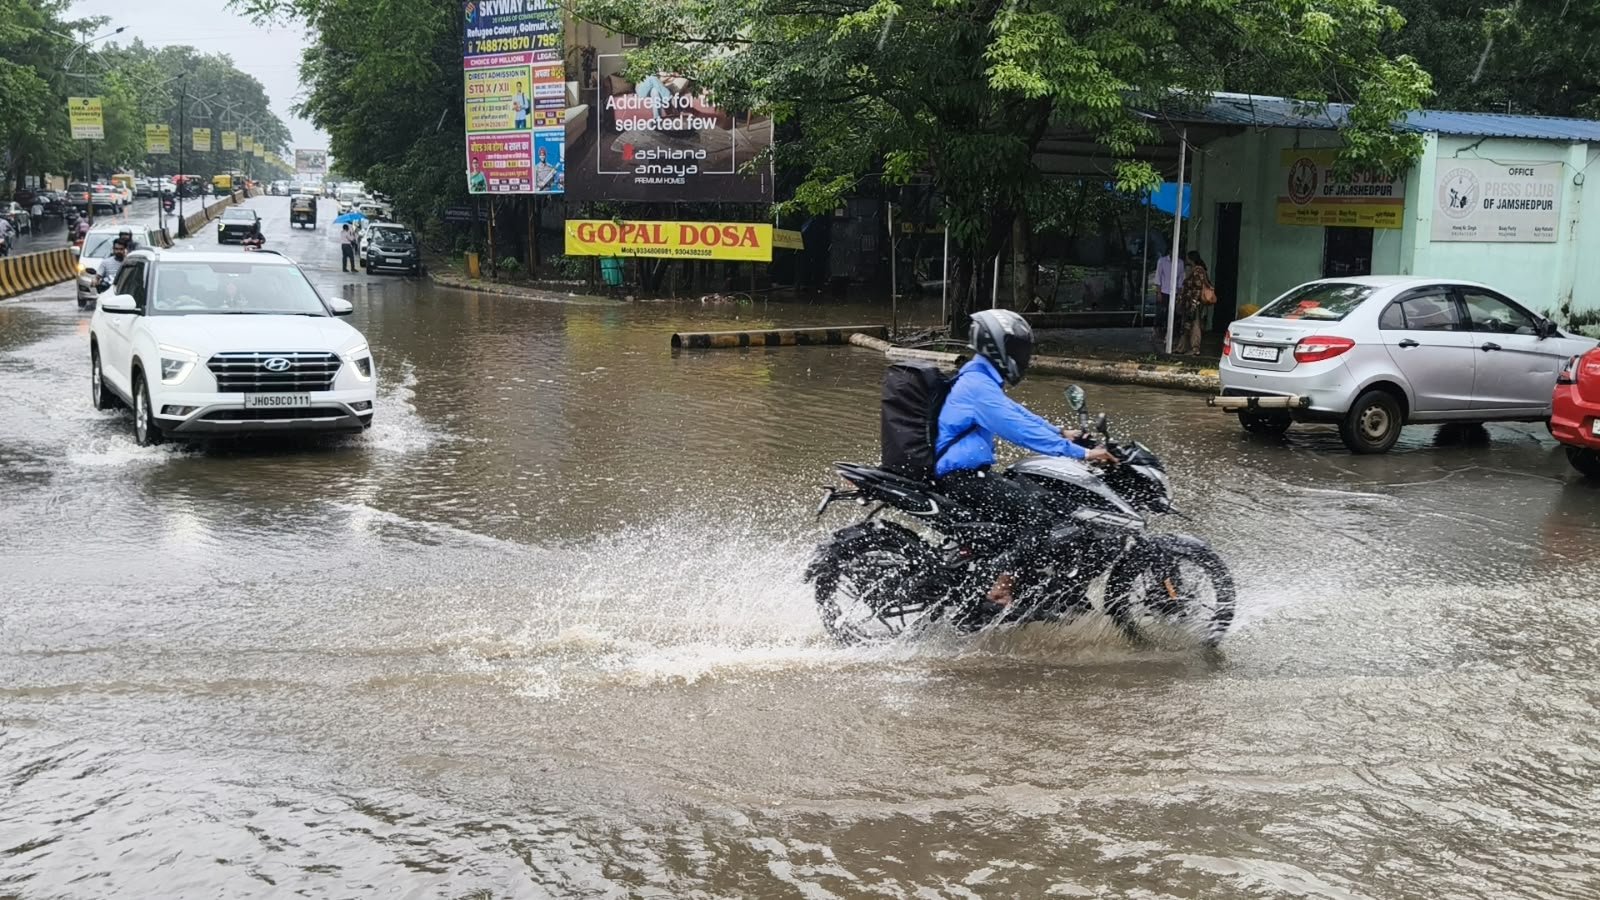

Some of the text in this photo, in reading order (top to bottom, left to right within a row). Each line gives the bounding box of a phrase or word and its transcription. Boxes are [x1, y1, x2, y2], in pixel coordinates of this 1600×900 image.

[480, 0, 524, 17] SKYWAY
[499, 15, 511, 23] YEARS
[467, 28, 493, 39] Refugee
[494, 24, 519, 36] Colony,
[476, 36, 529, 53] 7488731870
[531, 35, 536, 49] /
[471, 55, 525, 66] CHOICE OF MILLIONS
[469, 71, 487, 80] DIRECT
[488, 70, 519, 79] ADMISSION
[519, 69, 526, 77] IN
[469, 82, 509, 94] STD X / XII
[606, 93, 670, 110] Address
[673, 92, 693, 108] for
[615, 114, 717, 131] selected few
[635, 164, 698, 177] amaya
[1509, 168, 1534, 176] OFFICE
[1323, 185, 1335, 195] OF
[1485, 182, 1554, 198] PRESS CLUB
[1483, 198, 1553, 210] OF JAMSHEDPUR
[577, 222, 671, 245] GOPAL
[678, 224, 760, 248] DOSA
